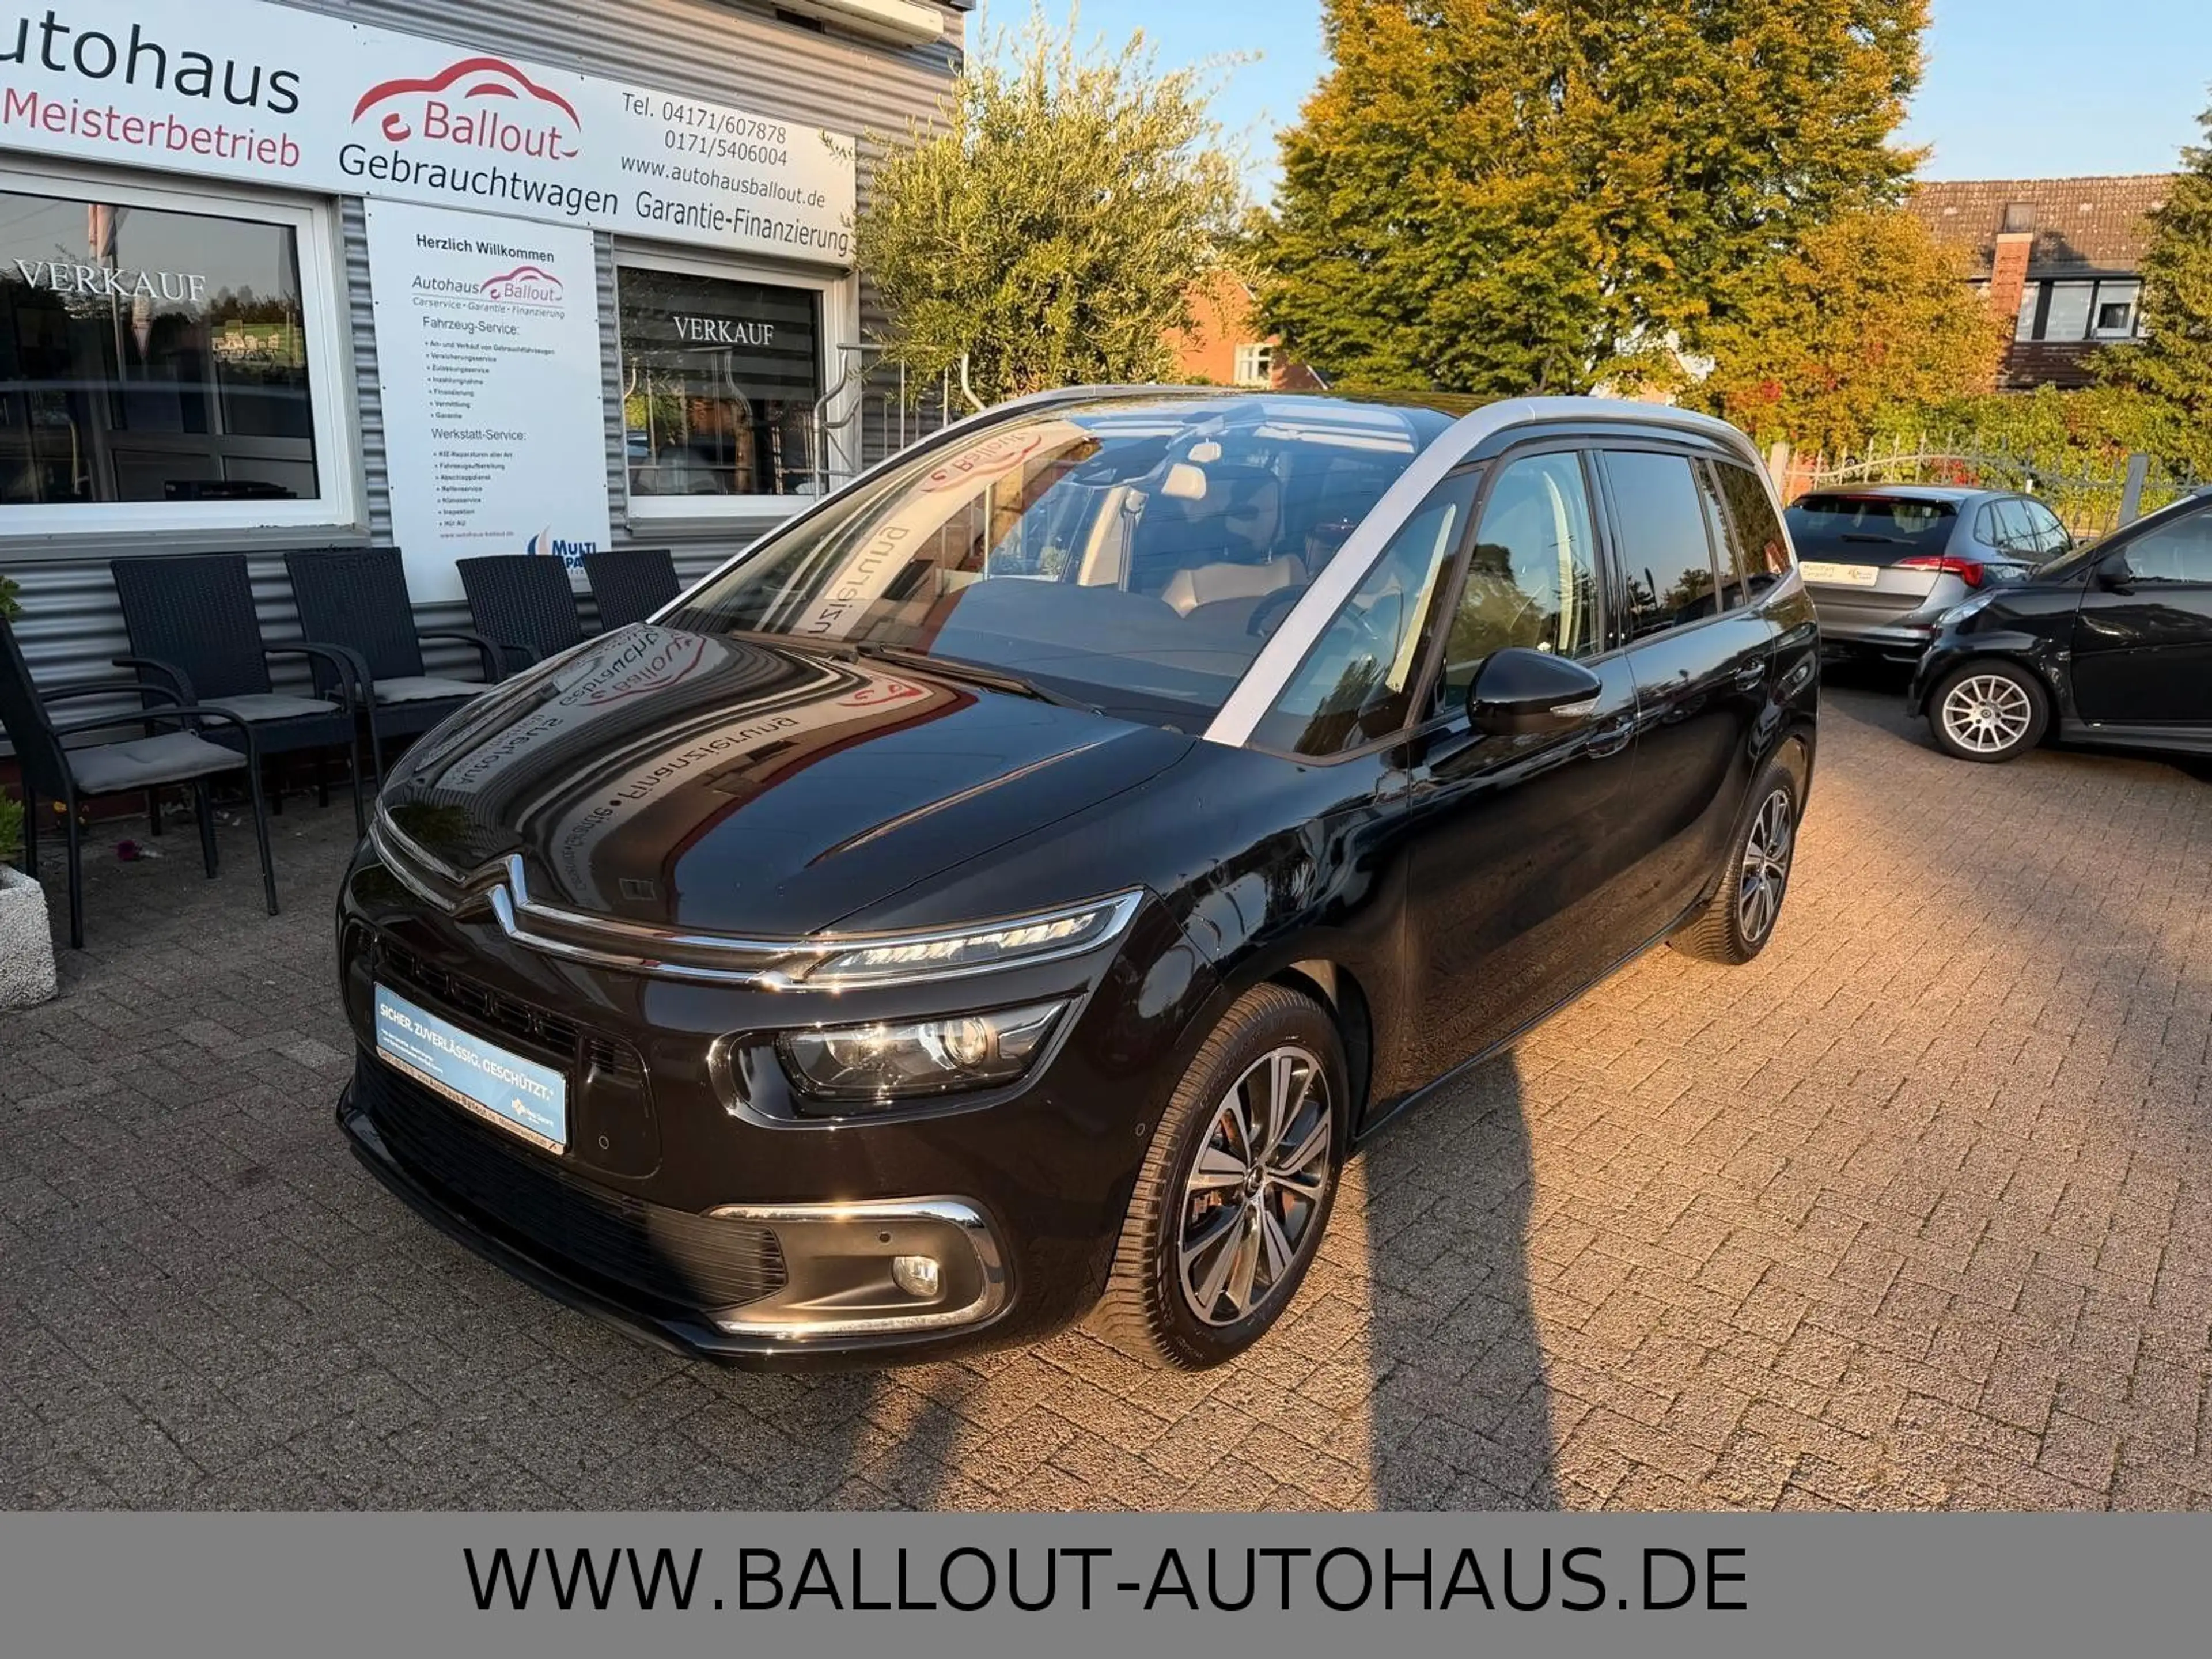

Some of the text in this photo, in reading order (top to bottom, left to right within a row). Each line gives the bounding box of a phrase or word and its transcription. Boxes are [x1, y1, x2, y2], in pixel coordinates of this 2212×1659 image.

[2, 87, 300, 167] Meisterbetrieb
[423, 100, 562, 160] Ballout
[622, 92, 787, 145] Tel. 04171/607878
[664, 130, 787, 166] 0171/5406004
[339, 143, 849, 257] Gebrauchtwagen Garantie-Finanzierung
[620, 156, 825, 209] www.autohausballout.de
[416, 234, 555, 263] Herzlich Willkommen
[12, 258, 206, 302] VERKAUF
[411, 275, 555, 302] Autohaus Ballout
[422, 316, 521, 336] Fahrzeug-Service:
[673, 316, 774, 346] VERKAUF
[431, 428, 527, 441] Werkstatt-Service:
[414, 1023, 480, 1070] ZUVERLÄSSIG.
